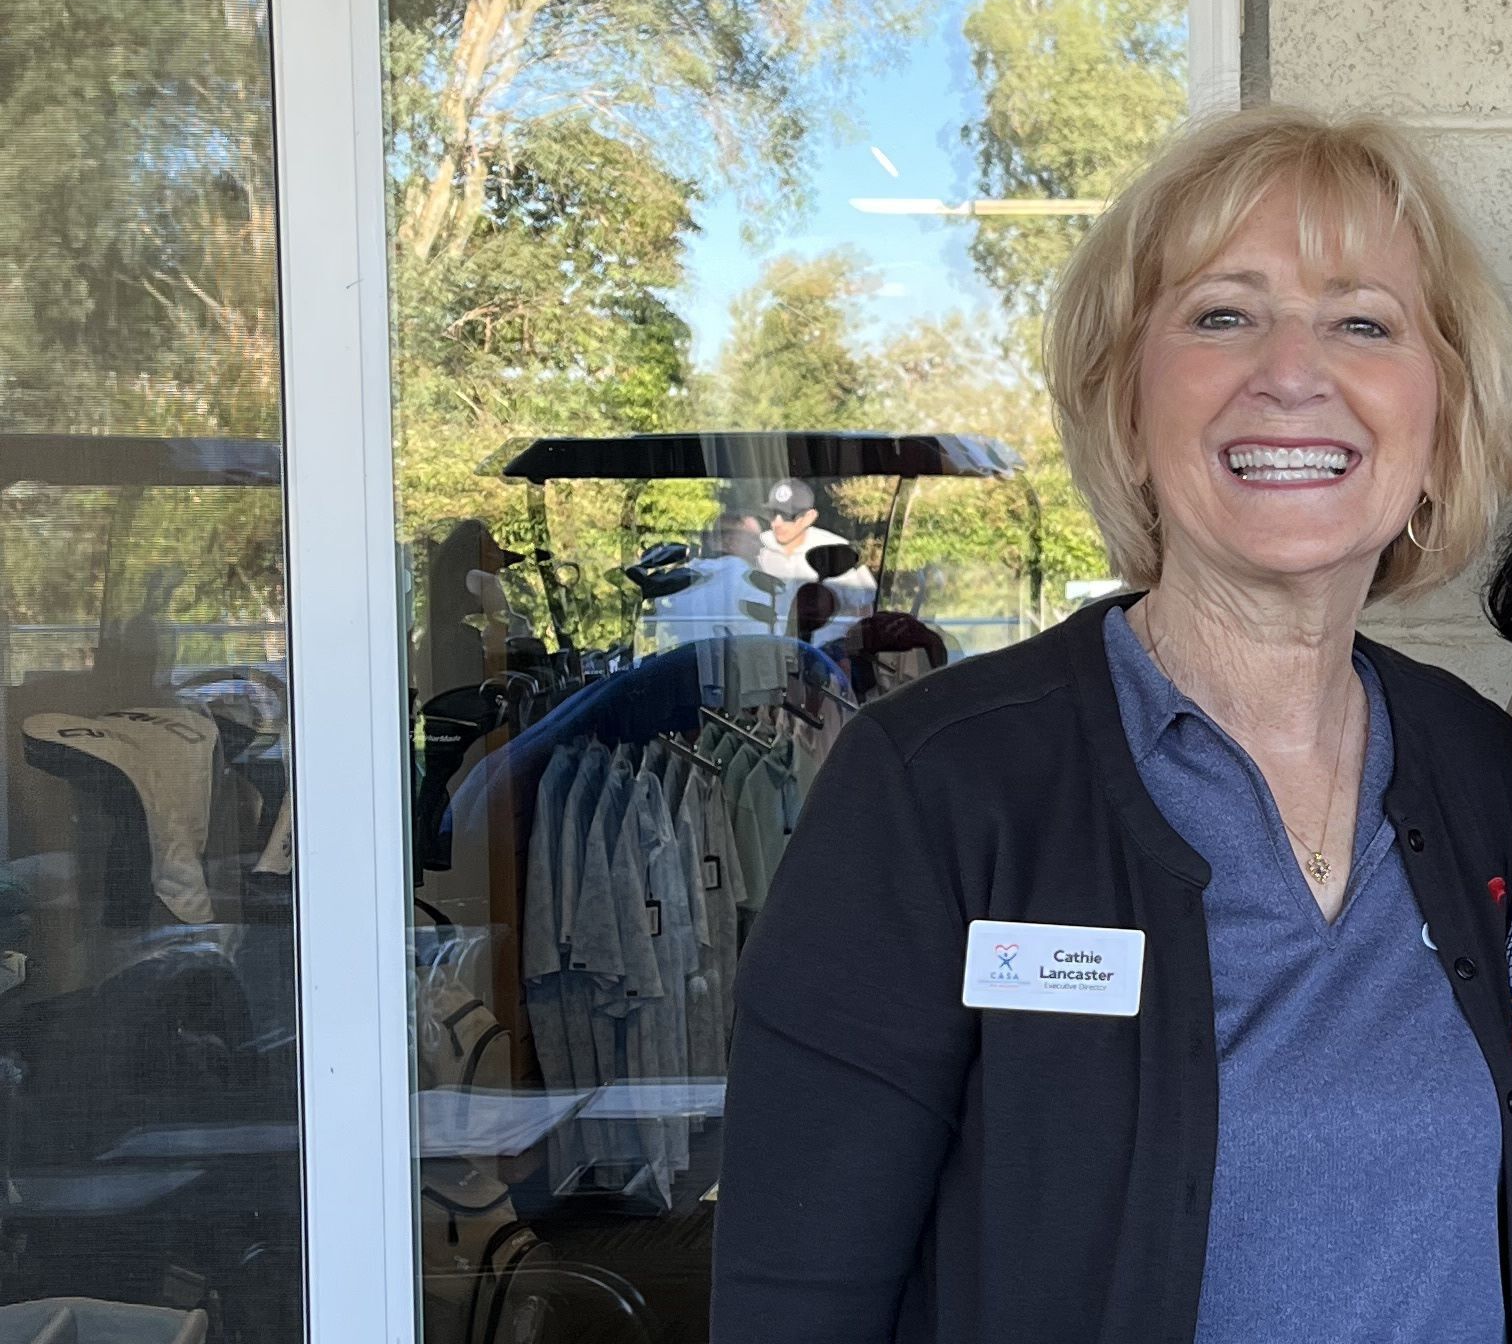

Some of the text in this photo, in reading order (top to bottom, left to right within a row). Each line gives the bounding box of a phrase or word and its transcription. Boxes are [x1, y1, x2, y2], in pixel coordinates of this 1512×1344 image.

[1053, 949, 1103, 965] Cathie
[989, 971, 1020, 980] CASA
[1039, 965, 1115, 982] Lancaster
